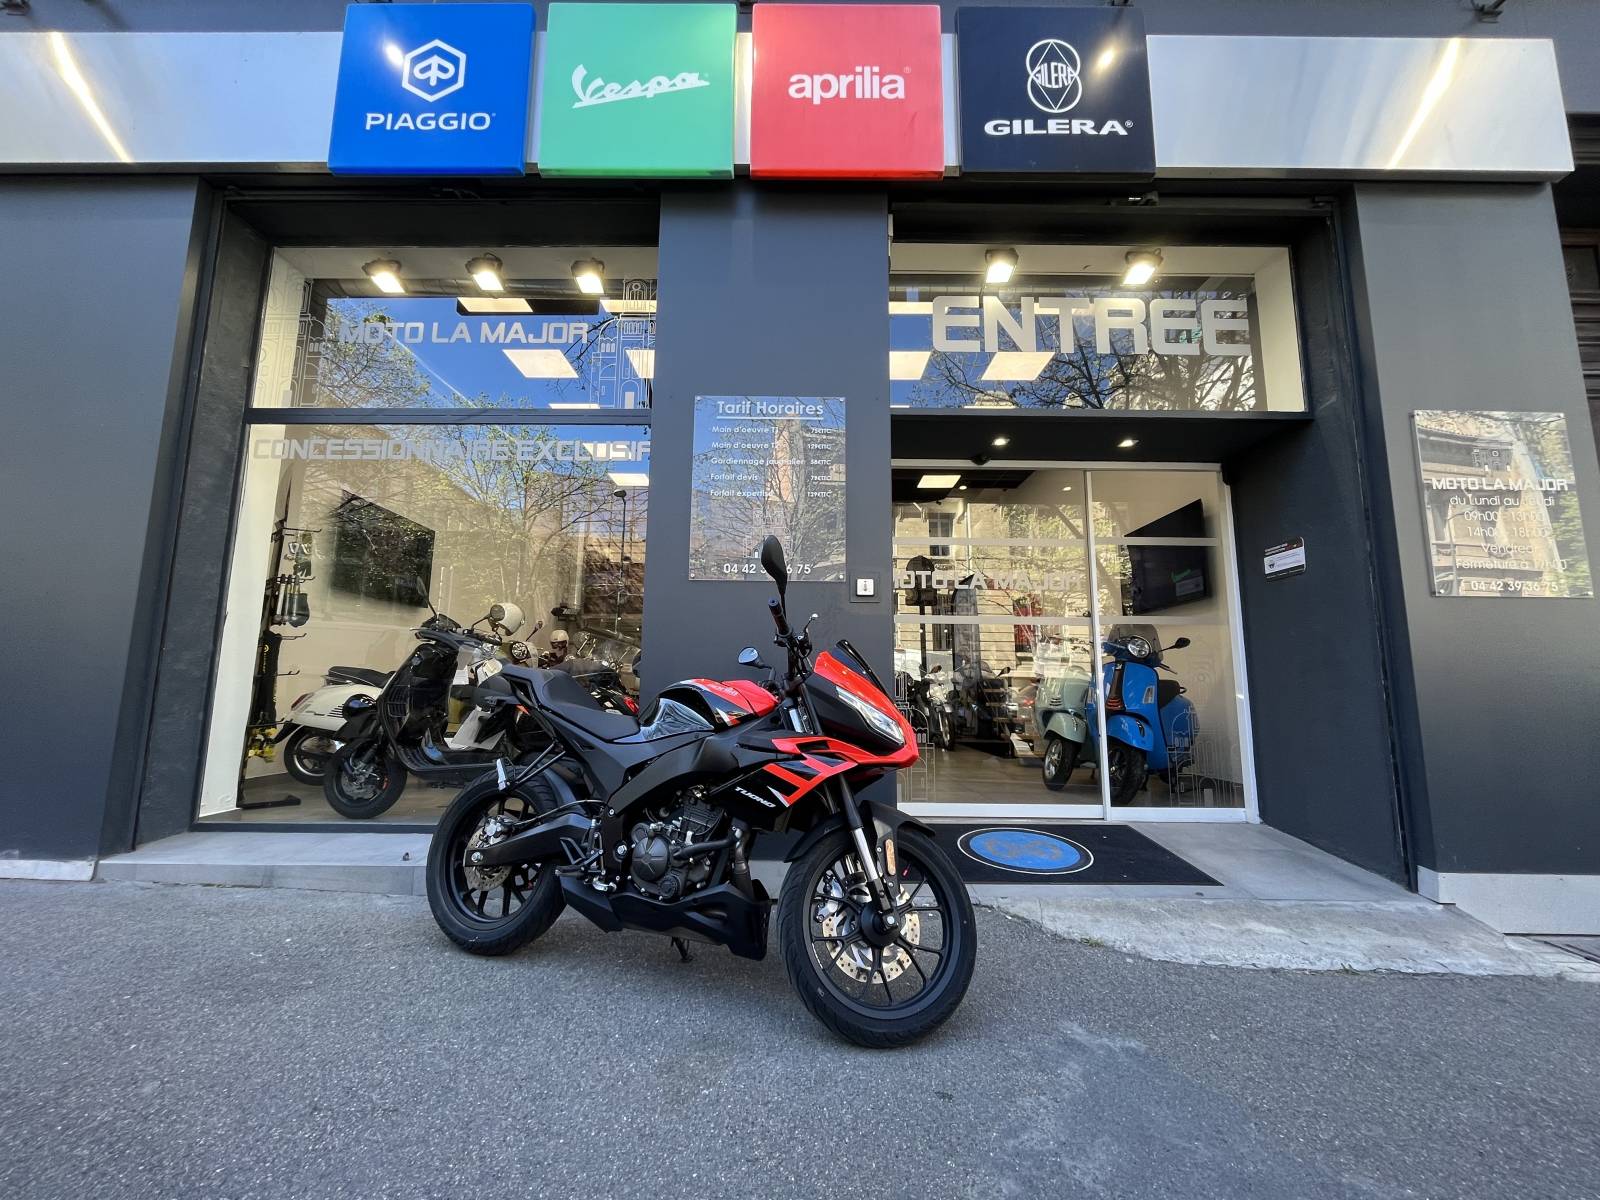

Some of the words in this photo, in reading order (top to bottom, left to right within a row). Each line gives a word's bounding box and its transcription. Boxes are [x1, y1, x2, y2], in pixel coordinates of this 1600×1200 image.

[1034, 61, 1076, 89] GILERA
[571, 64, 710, 108] Vespa
[788, 66, 905, 104] aprilia
[365, 112, 491, 131] PIAGGIO
[984, 119, 1128, 136] GILERA
[339, 321, 424, 344] MOTO
[431, 321, 472, 344] LA
[480, 321, 589, 344] MAJOR
[932, 296, 1251, 356] ENTREE
[717, 400, 751, 414] Tarif
[756, 400, 824, 415] Horaires
[711, 425, 732, 433] Main
[734, 425, 769, 433] d'oeuvre
[253, 437, 510, 461] CONCESSIONNAIRE
[517, 439, 650, 462] EXCLUSIF
[711, 441, 731, 449] Main
[733, 441, 769, 449] d'oeuvre
[711, 457, 765, 466] Gardiennage
[710, 473, 735, 481] Forfait
[737, 473, 758, 481] devis
[1431, 477, 1480, 490] MOTO
[1482, 478, 1507, 491] LA
[1508, 478, 1569, 492] MAJOR
[710, 489, 735, 497] Forfait
[1449, 495, 1466, 505] du
[1503, 497, 1520, 506] au
[723, 563, 739, 574] 04
[741, 563, 757, 574] 42
[797, 564, 812, 575] 75
[955, 571, 987, 590] LA
[993, 571, 1081, 591] MAJOR
[1489, 581, 1505, 591] 42
[1507, 581, 1522, 591] 39
[735, 786, 777, 808] TUONO
